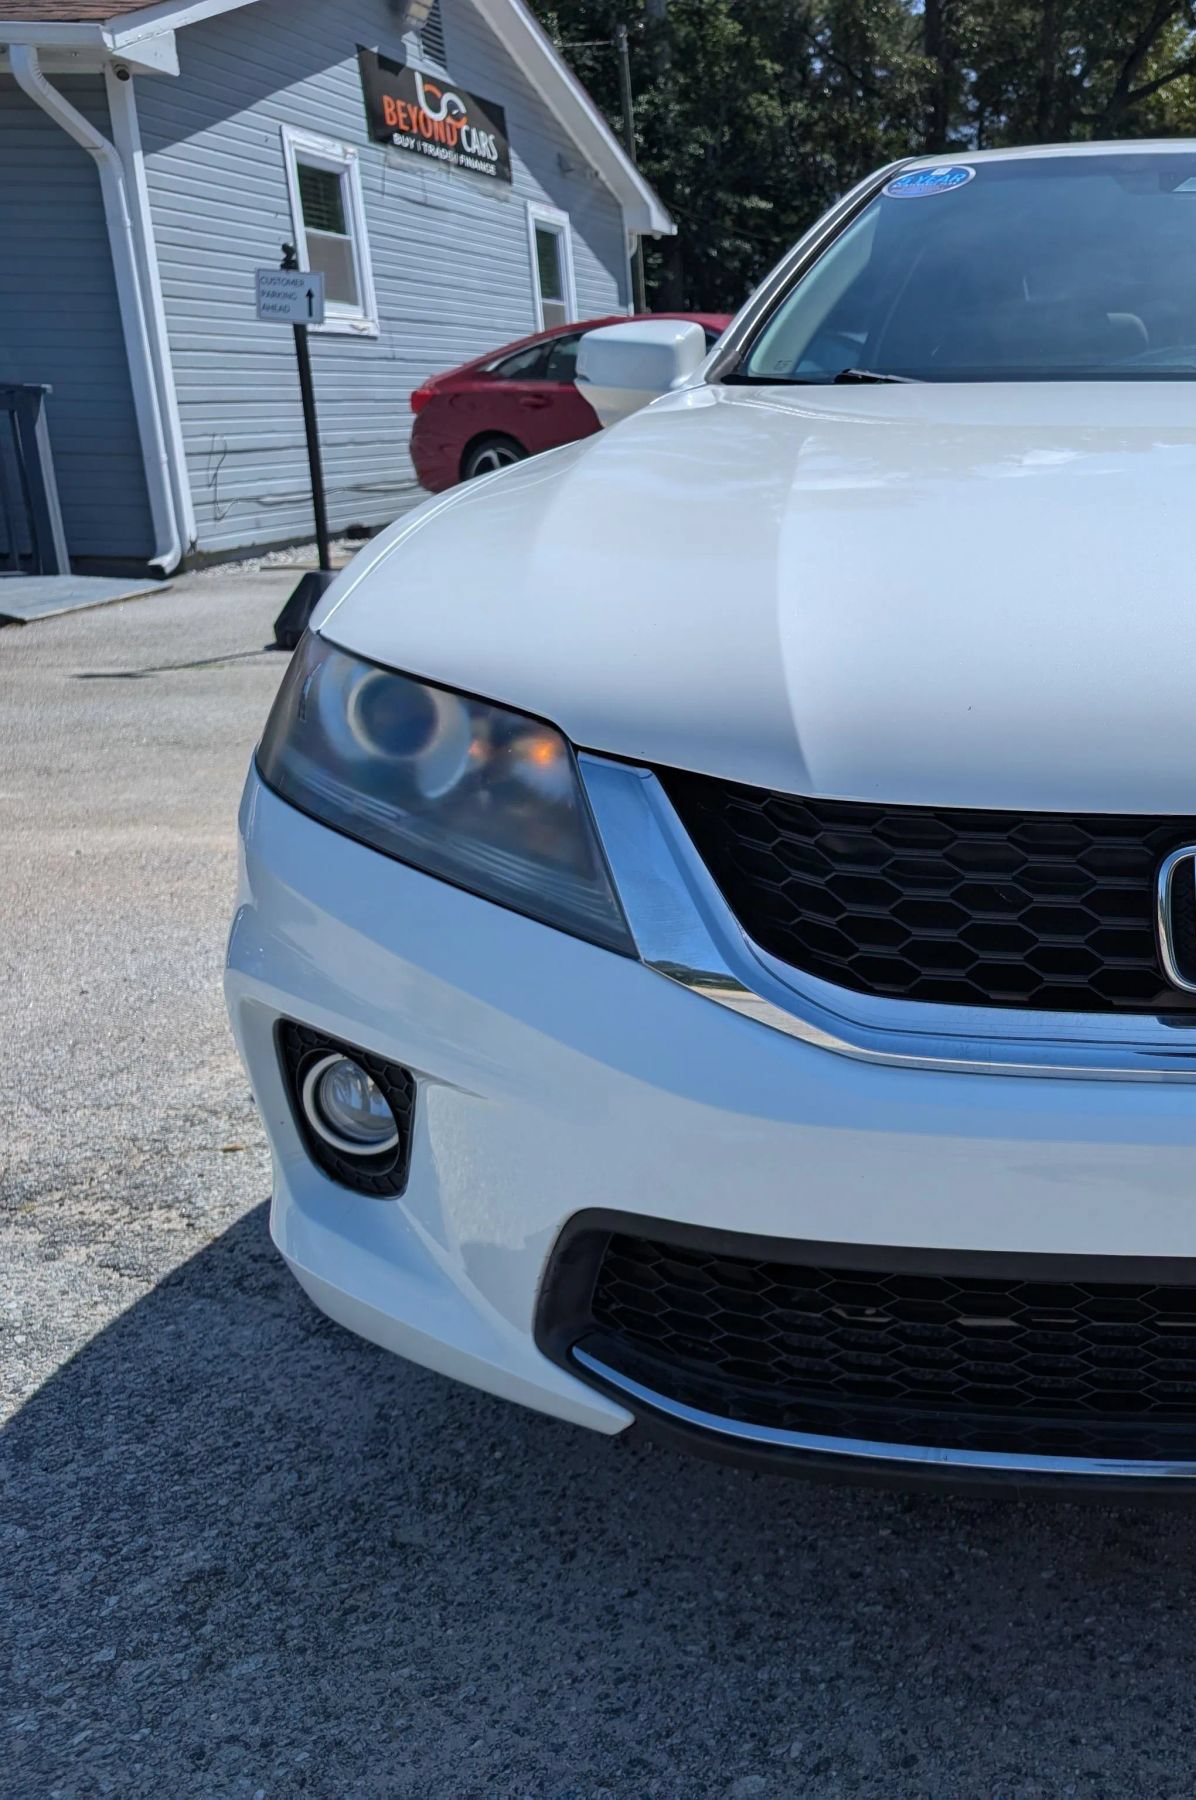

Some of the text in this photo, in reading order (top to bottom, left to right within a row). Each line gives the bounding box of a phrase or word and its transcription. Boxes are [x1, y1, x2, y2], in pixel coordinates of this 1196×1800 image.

[383, 95, 499, 161] BEYOND CARS
[393, 133, 415, 149] BUY
[459, 155, 497, 176] FINANCE
[260, 276, 305, 287] CUSTOMER
